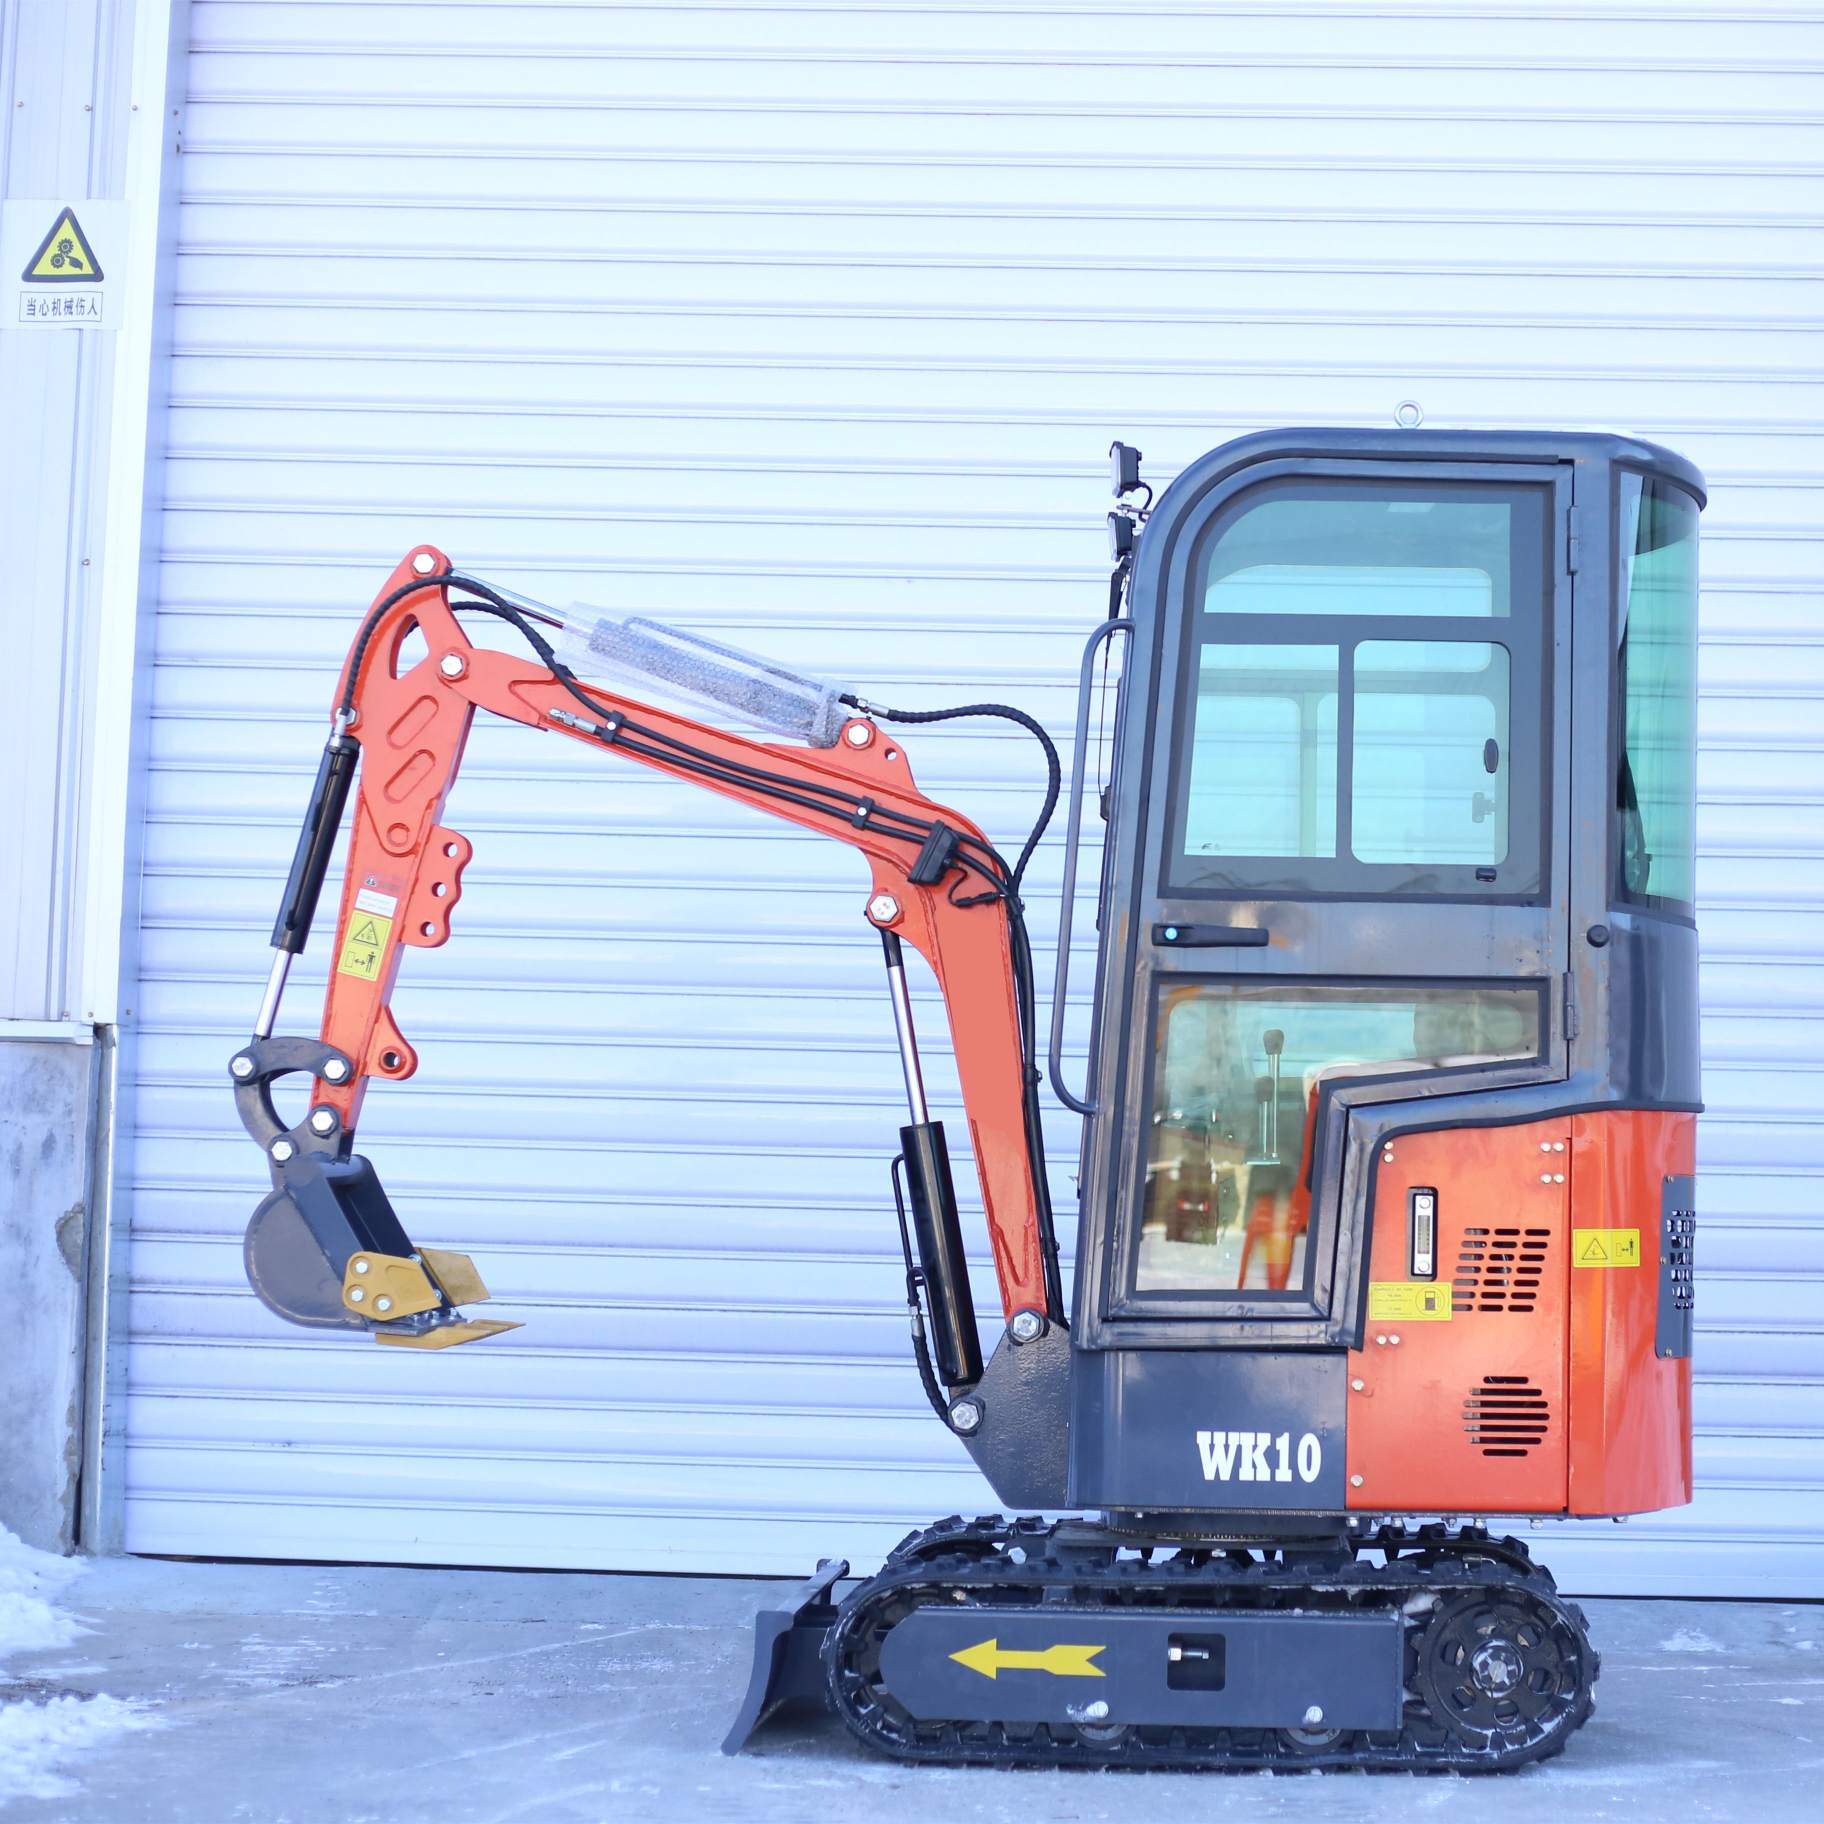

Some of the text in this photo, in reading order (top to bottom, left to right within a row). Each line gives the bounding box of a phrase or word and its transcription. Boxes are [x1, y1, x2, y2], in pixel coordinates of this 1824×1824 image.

[26, 297, 98, 317] 当心机械伤人
[1196, 1430, 1322, 1483] WK10
